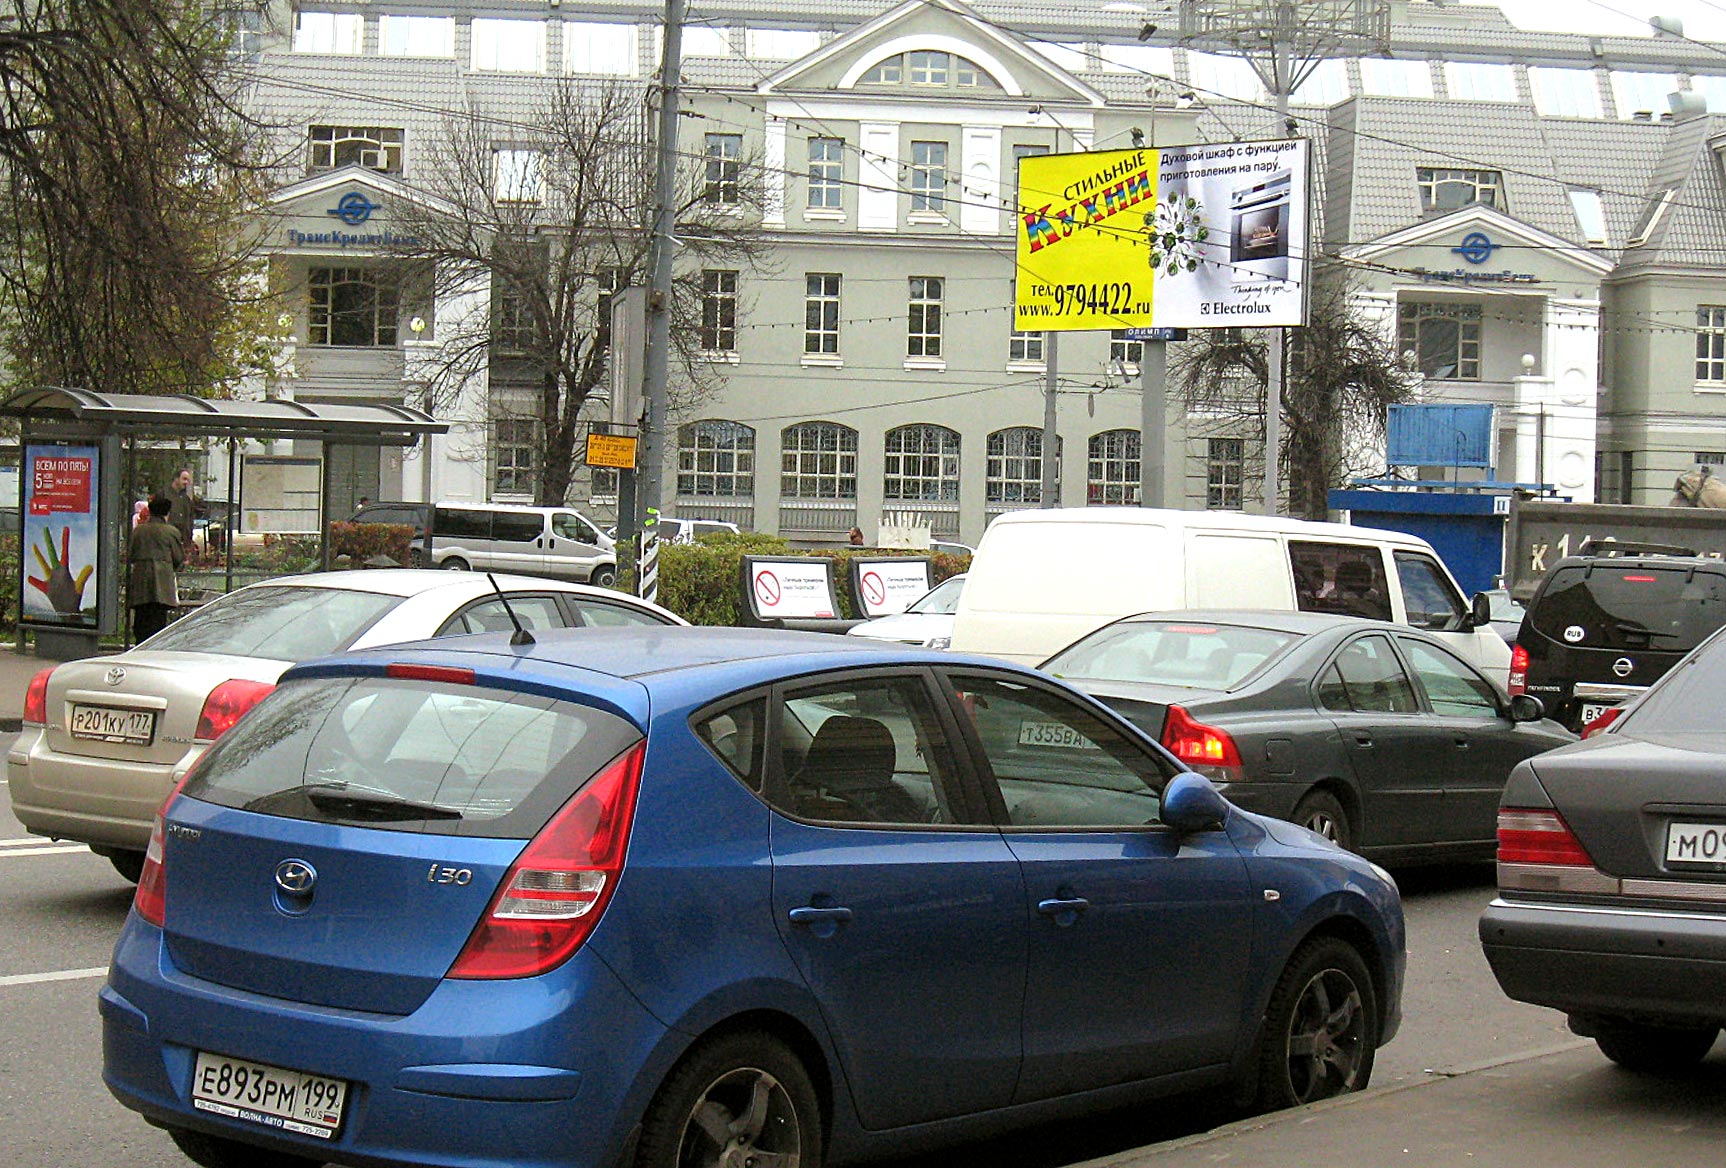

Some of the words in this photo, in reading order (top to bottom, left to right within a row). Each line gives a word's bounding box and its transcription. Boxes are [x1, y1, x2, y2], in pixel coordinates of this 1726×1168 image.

[1160, 150, 1204, 166] Духовой
[1205, 147, 1235, 160] шкаф
[1236, 148, 1243, 156] с
[1245, 141, 1297, 156] функцией
[1063, 151, 1146, 201] СТИЛЬНЫЕ
[1160, 167, 1237, 182] приготовления
[1239, 165, 1251, 174] на
[1031, 284, 1054, 297] тел.
[1213, 301, 1271, 314] Electrolux
[36, 460, 56, 471] ВСЕМ
[58, 461, 68, 471] ПО
[70, 461, 89, 472] ПЯТЬ!
[35, 472, 43, 489] 5
[1566, 629, 1582, 638] RUS
[302, 1078, 339, 1110] 199
[304, 1107, 323, 1120] RUS
